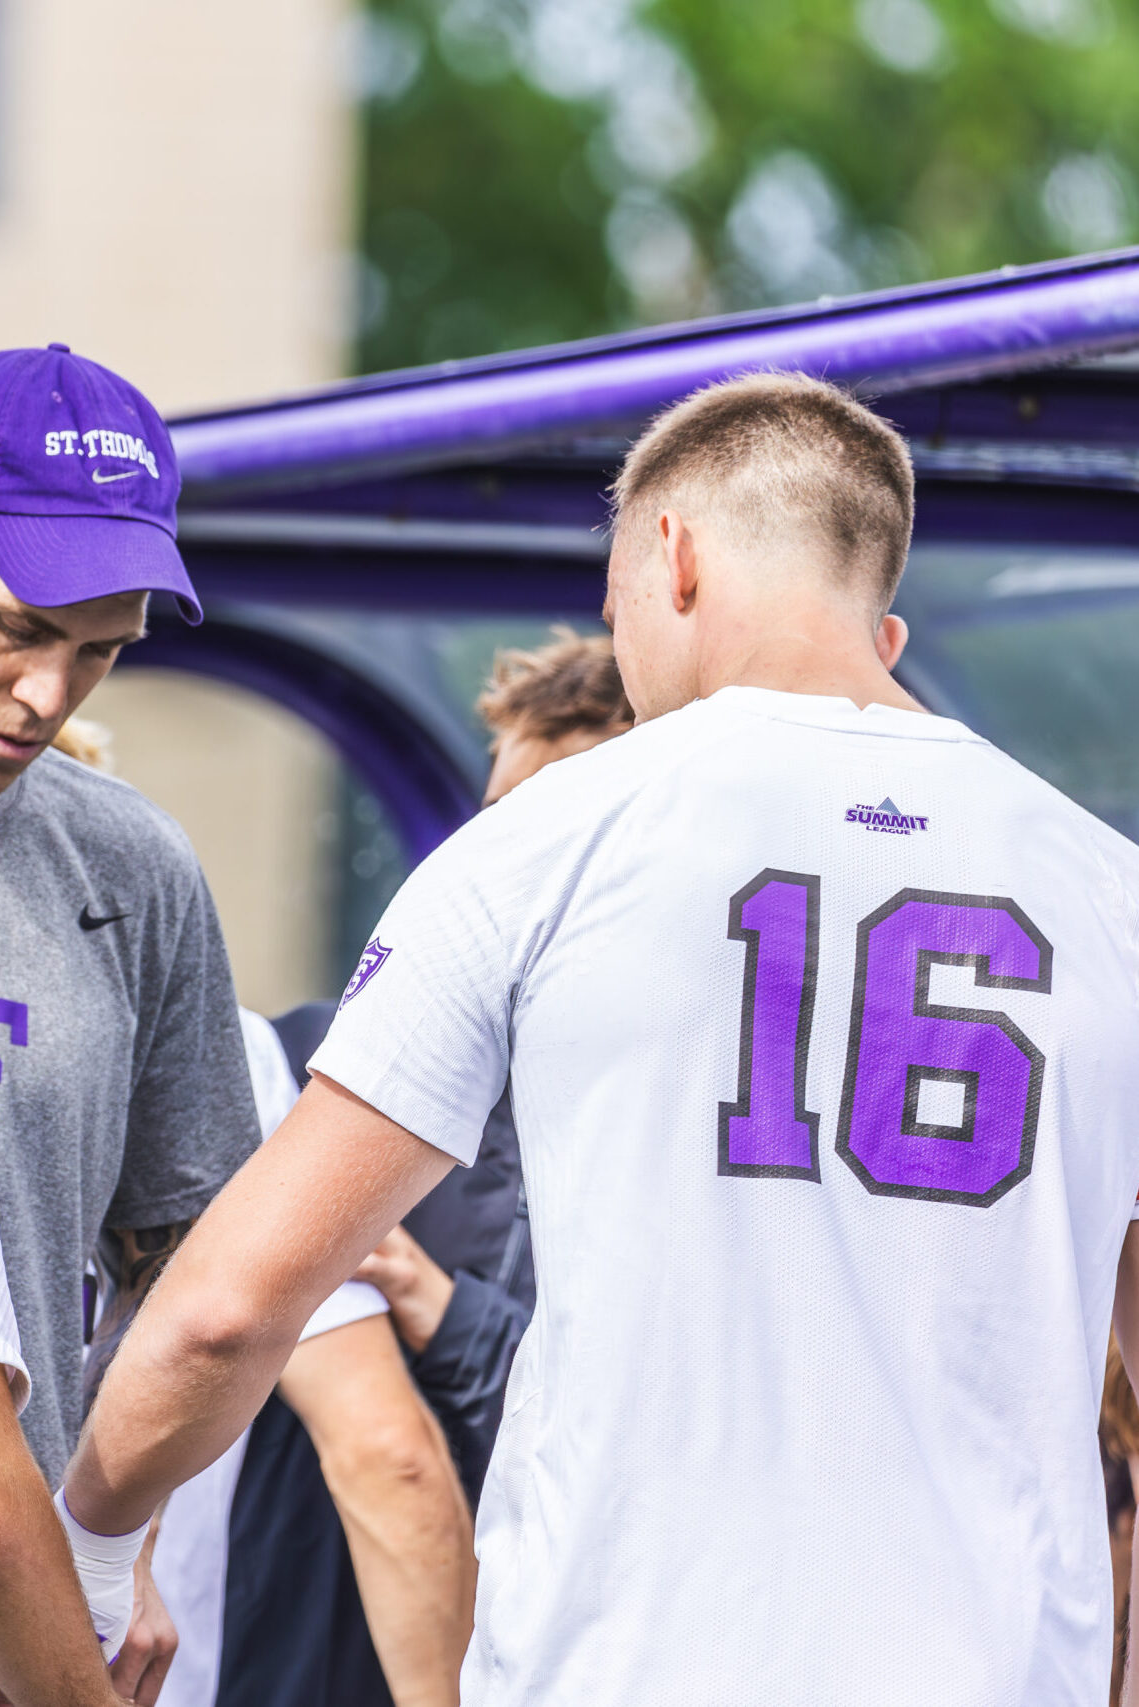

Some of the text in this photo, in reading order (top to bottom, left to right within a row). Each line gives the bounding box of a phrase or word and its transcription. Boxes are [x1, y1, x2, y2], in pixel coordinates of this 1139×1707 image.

[855, 803, 875, 811] THE
[845, 809, 929, 831] SUMMIT
[866, 825, 912, 835] LEAGUE
[717, 867, 1054, 1208] 16
